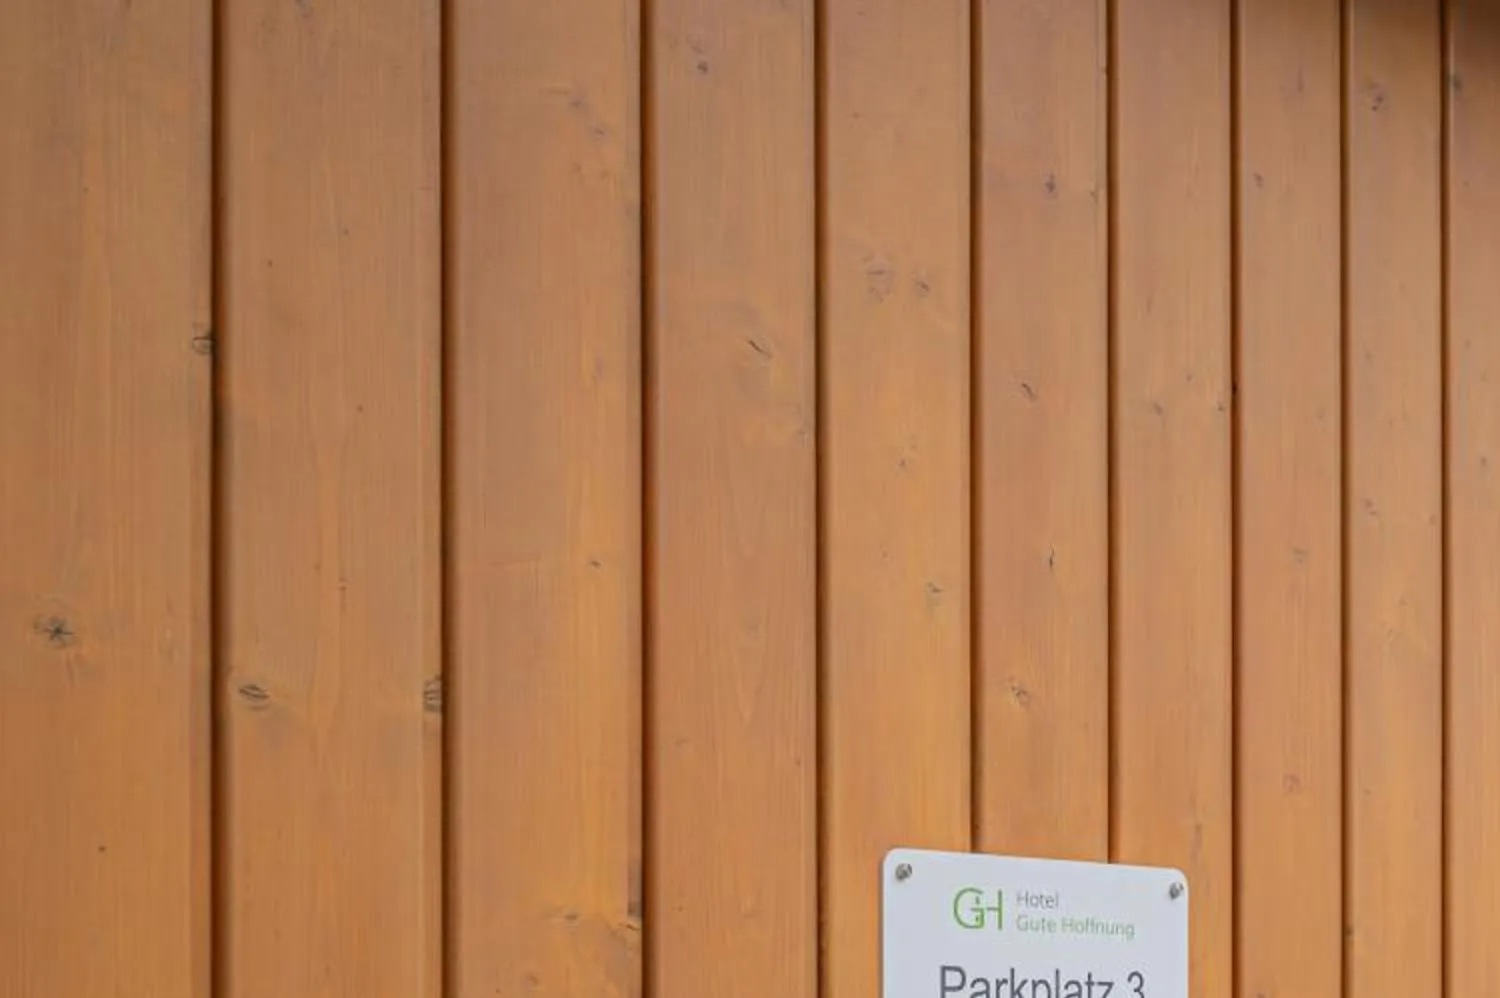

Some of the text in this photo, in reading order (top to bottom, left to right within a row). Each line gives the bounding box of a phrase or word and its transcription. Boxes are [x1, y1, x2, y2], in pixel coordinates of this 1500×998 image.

[1015, 891, 1059, 909] Hotel
[1015, 914, 1136, 940] Gute Hoffnung
